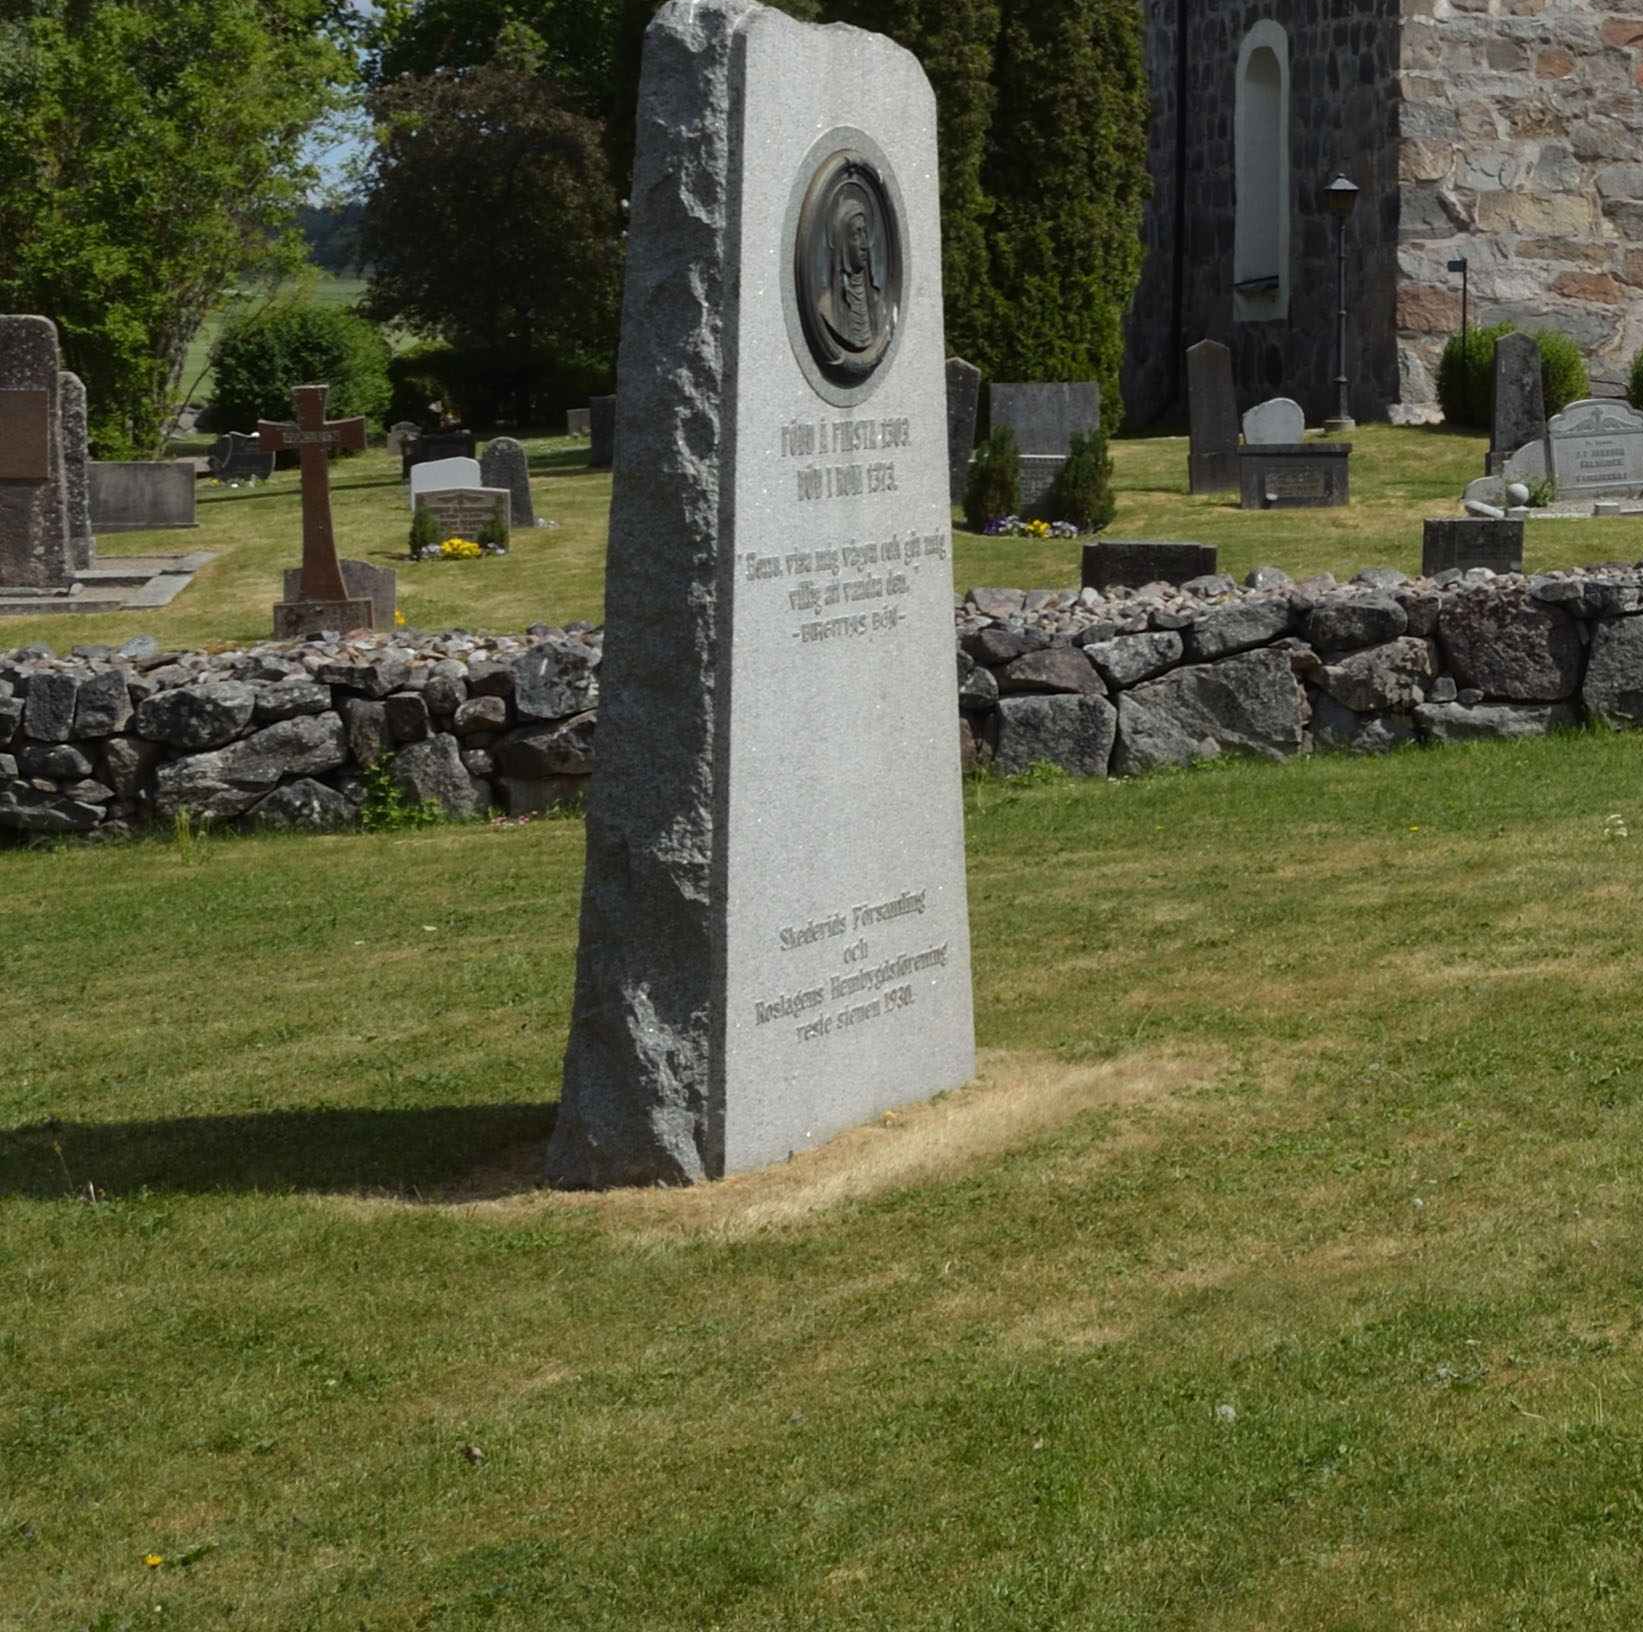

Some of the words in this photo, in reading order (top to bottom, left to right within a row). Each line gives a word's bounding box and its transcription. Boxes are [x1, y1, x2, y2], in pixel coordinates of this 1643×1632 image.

[826, 467, 833, 498] I
[785, 546, 812, 575] visa
[815, 542, 839, 576] mig
[842, 538, 877, 573] vägen
[881, 534, 901, 561] och
[904, 530, 921, 566] gör
[924, 527, 947, 560] mig
[789, 580, 821, 616] villig
[824, 579, 840, 606] att
[843, 572, 883, 603] vandra
[779, 912, 847, 951] Skederids
[852, 889, 926, 930] Församling
[843, 938, 869, 964] och
[755, 986, 824, 1026] Roslagens
[796, 1013, 832, 1043] reste
[837, 998, 881, 1029] stenen
